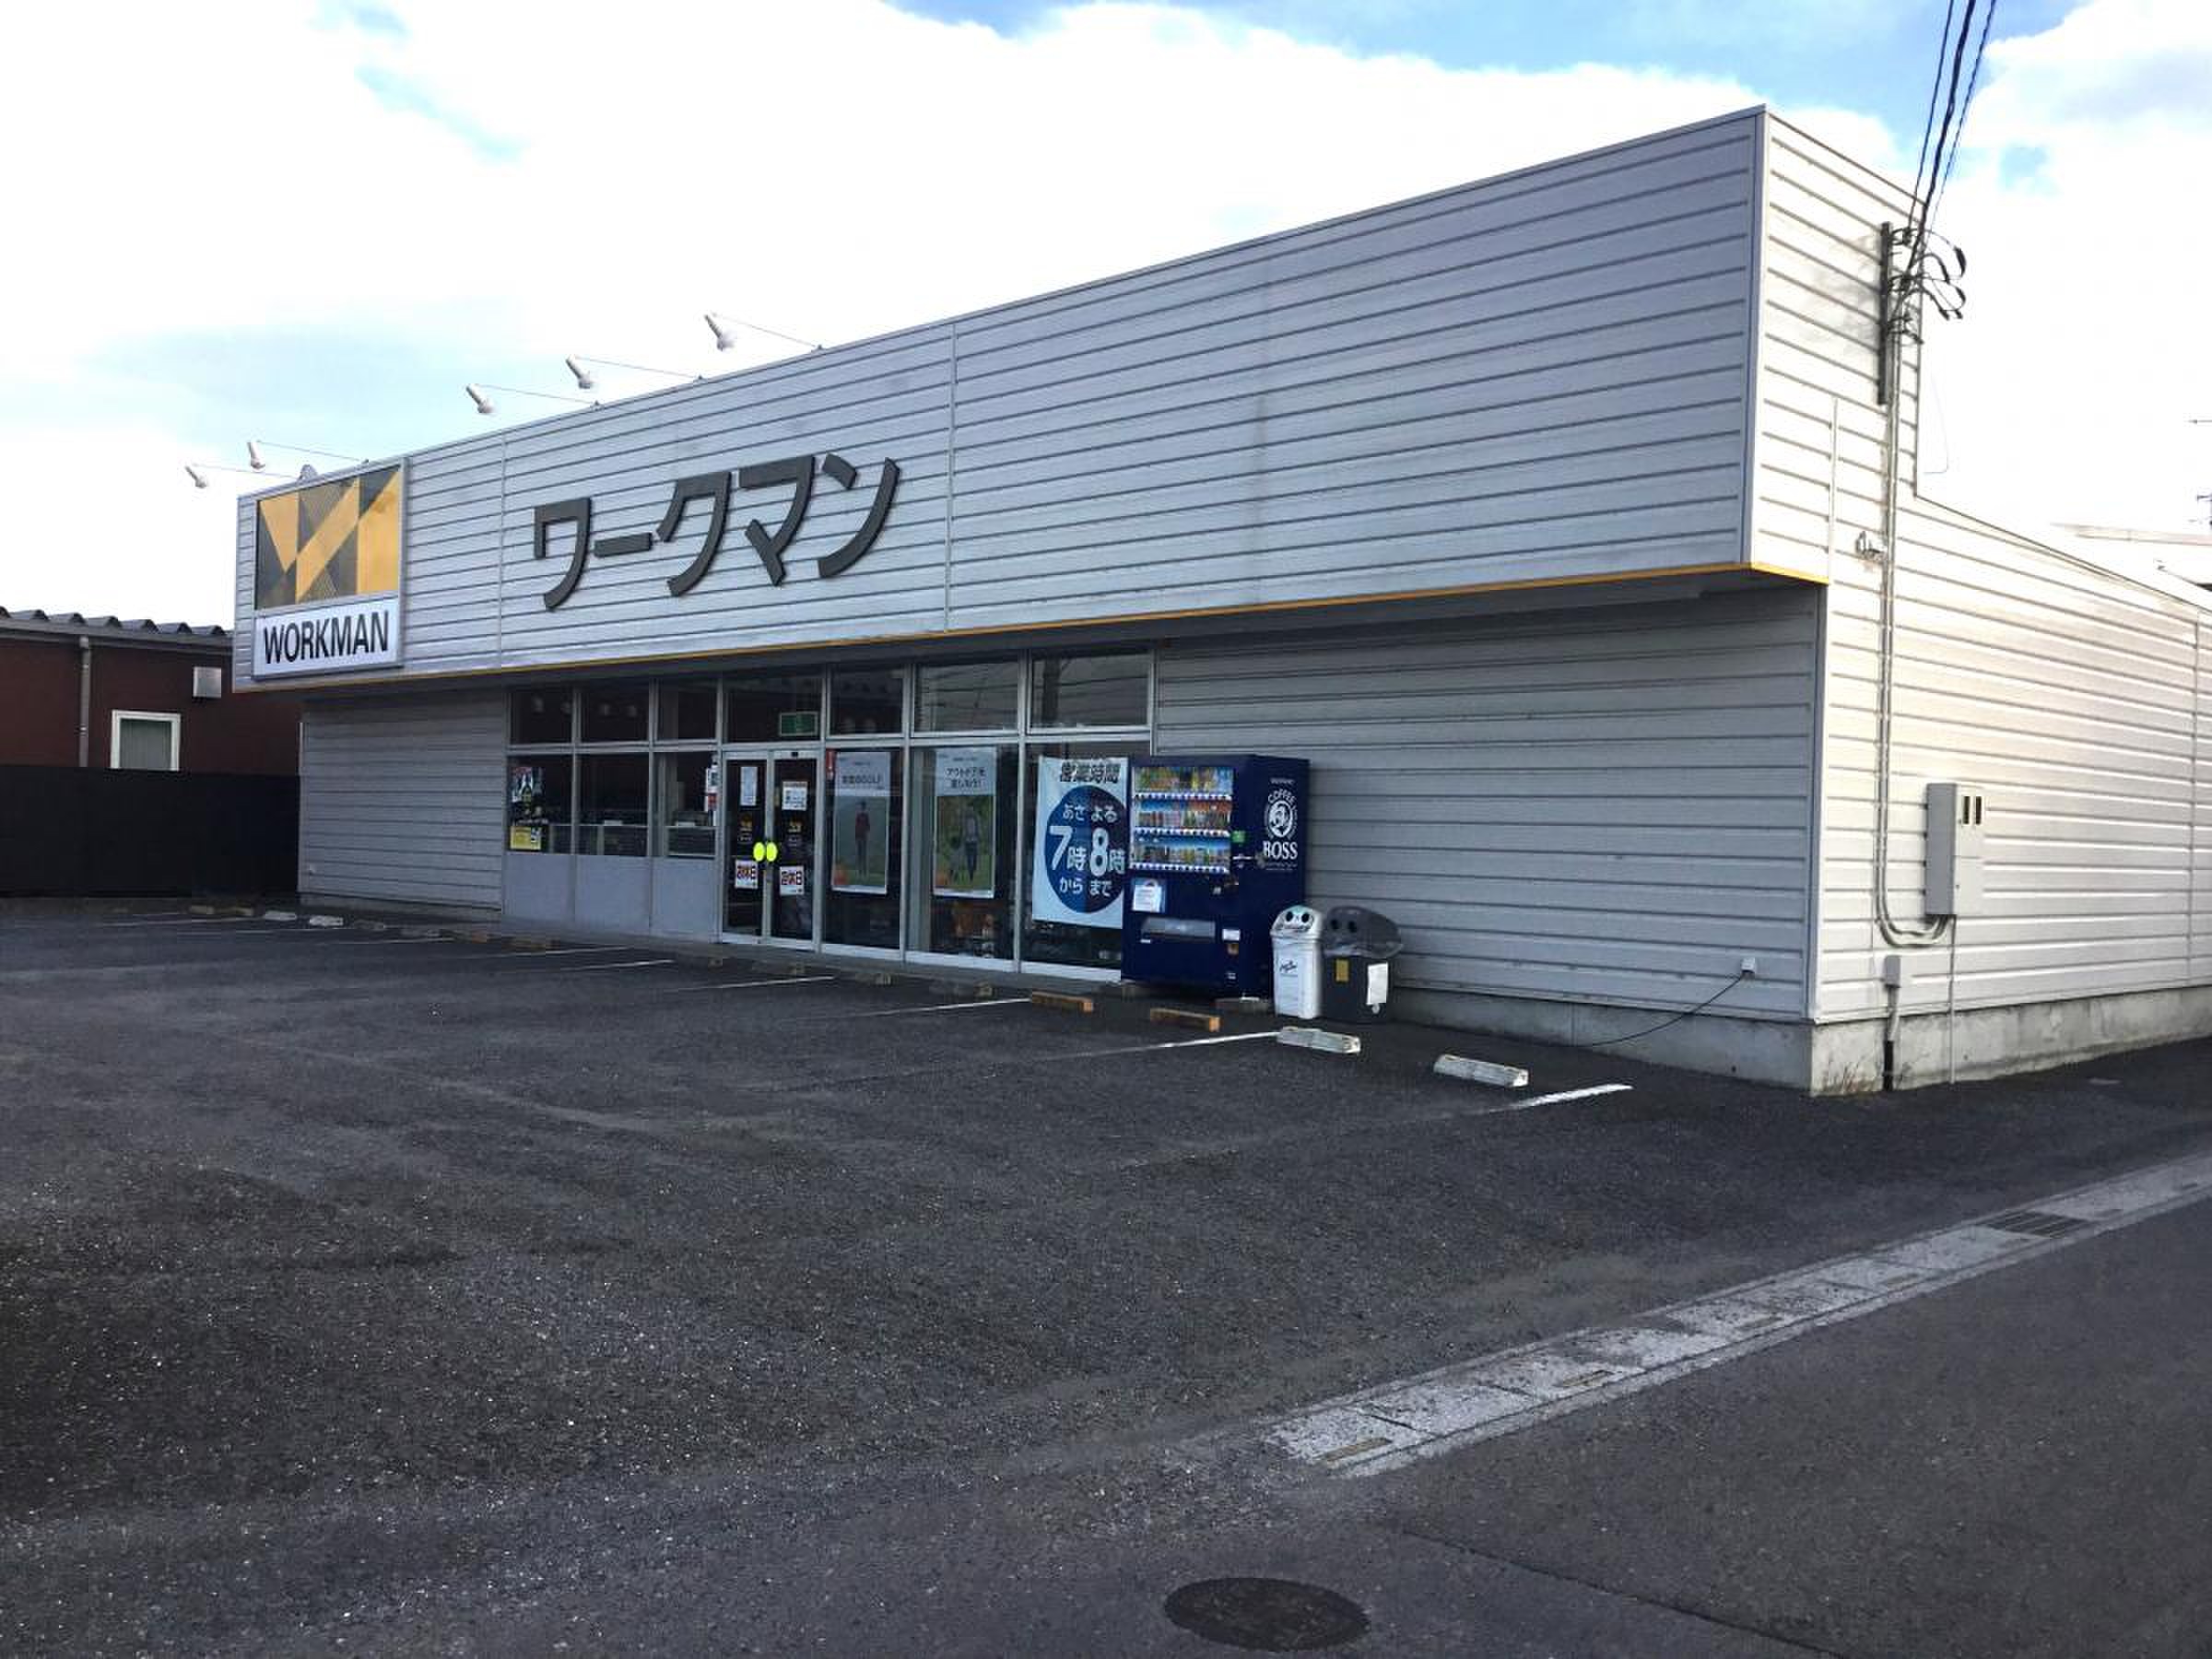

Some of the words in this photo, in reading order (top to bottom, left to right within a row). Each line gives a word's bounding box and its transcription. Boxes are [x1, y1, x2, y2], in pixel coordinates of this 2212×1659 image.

[534, 453, 900, 612] ワークマン
[264, 610, 389, 664] WORKMAN
[1063, 804, 1085, 821] あさ
[1090, 805, 1117, 823] よる
[1263, 841, 1298, 860] BOSS
[1060, 877, 1083, 895] から
[1089, 878, 1112, 897] まで
